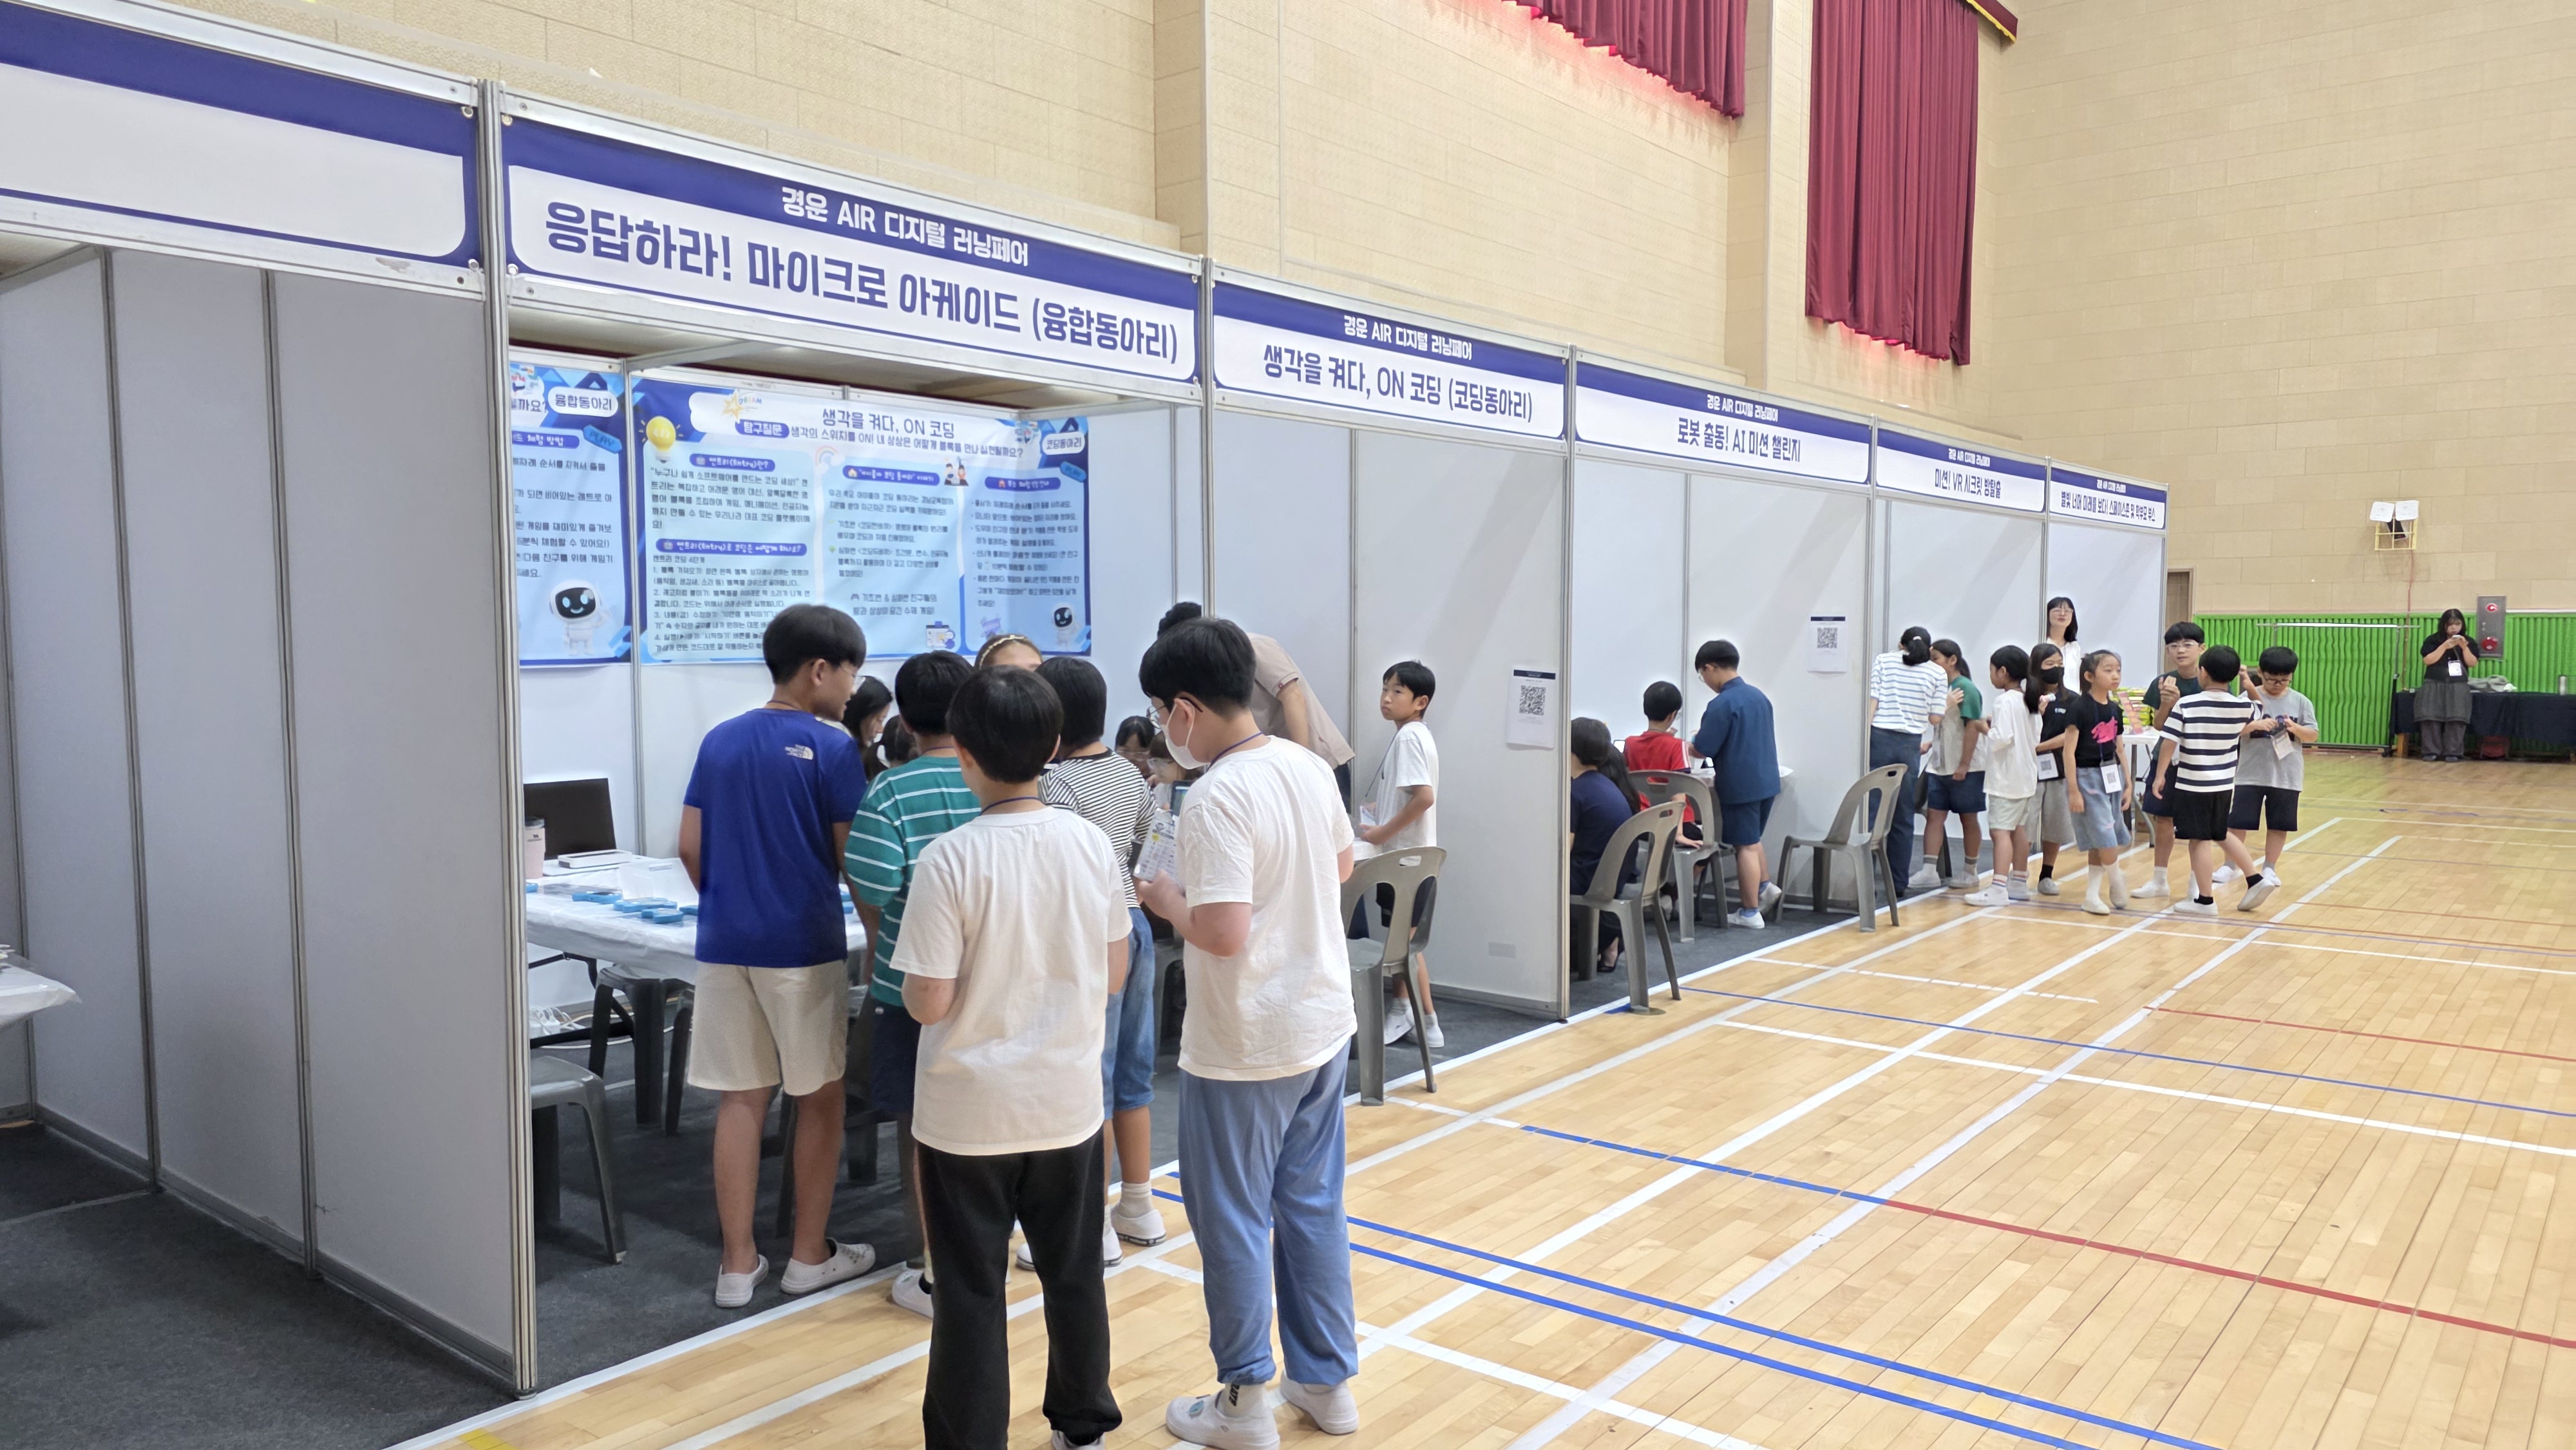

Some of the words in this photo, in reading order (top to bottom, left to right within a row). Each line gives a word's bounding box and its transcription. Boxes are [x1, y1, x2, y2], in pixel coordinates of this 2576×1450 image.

[782, 187, 829, 222] 경운
[838, 200, 875, 230] AIR
[884, 211, 945, 245] 디지털
[952, 223, 1029, 268] 러닝페어
[545, 201, 732, 281] 응답하라!
[748, 241, 888, 309] 마이크로
[900, 274, 1020, 335] 아케이드
[1032, 297, 1178, 363] (융합동아리)
[1344, 315, 1368, 338] 경운
[1372, 325, 1392, 344] AIR
[1396, 328, 1428, 351] 디지털
[1432, 335, 1472, 361] 러닝페어
[1264, 344, 1322, 384] 생각을
[1329, 357, 1371, 400] 켜다,
[1378, 367, 1405, 399] ON
[1410, 373, 1441, 405] 코딩
[1449, 378, 1532, 422] (코딩동아리)
[554, 393, 612, 411] 융합동아리
[1707, 394, 1720, 411] 경운
[1722, 398, 1734, 413] AIR
[1735, 400, 1753, 417] 디지털
[589, 431, 614, 447] PLAY
[743, 420, 782, 436] 탐구질문
[822, 408, 864, 429] 생각을
[869, 413, 898, 433] 켜다,
[904, 419, 925, 435] ON
[930, 420, 955, 439] 코딩
[791, 426, 817, 438] 생각의
[821, 429, 855, 442] 스위치를
[858, 433, 874, 444] ON!
[877, 433, 885, 445] 내
[887, 435, 911, 447] 상상은
[913, 438, 937, 451] 어떻게
[964, 444, 978, 455] 만나
[1046, 437, 1081, 450] 코딩동아리
[1678, 417, 1700, 446] 로봇
[1704, 422, 1728, 451] 출동!
[1732, 429, 1745, 453] AI
[1748, 431, 1768, 458] 미션
[1772, 435, 1801, 463] 챌린지
[1935, 468, 1951, 491] 미션!
[1953, 472, 1962, 492] VR
[1964, 474, 1982, 496] 시크릿
[1984, 477, 2001, 499] 방탈출
